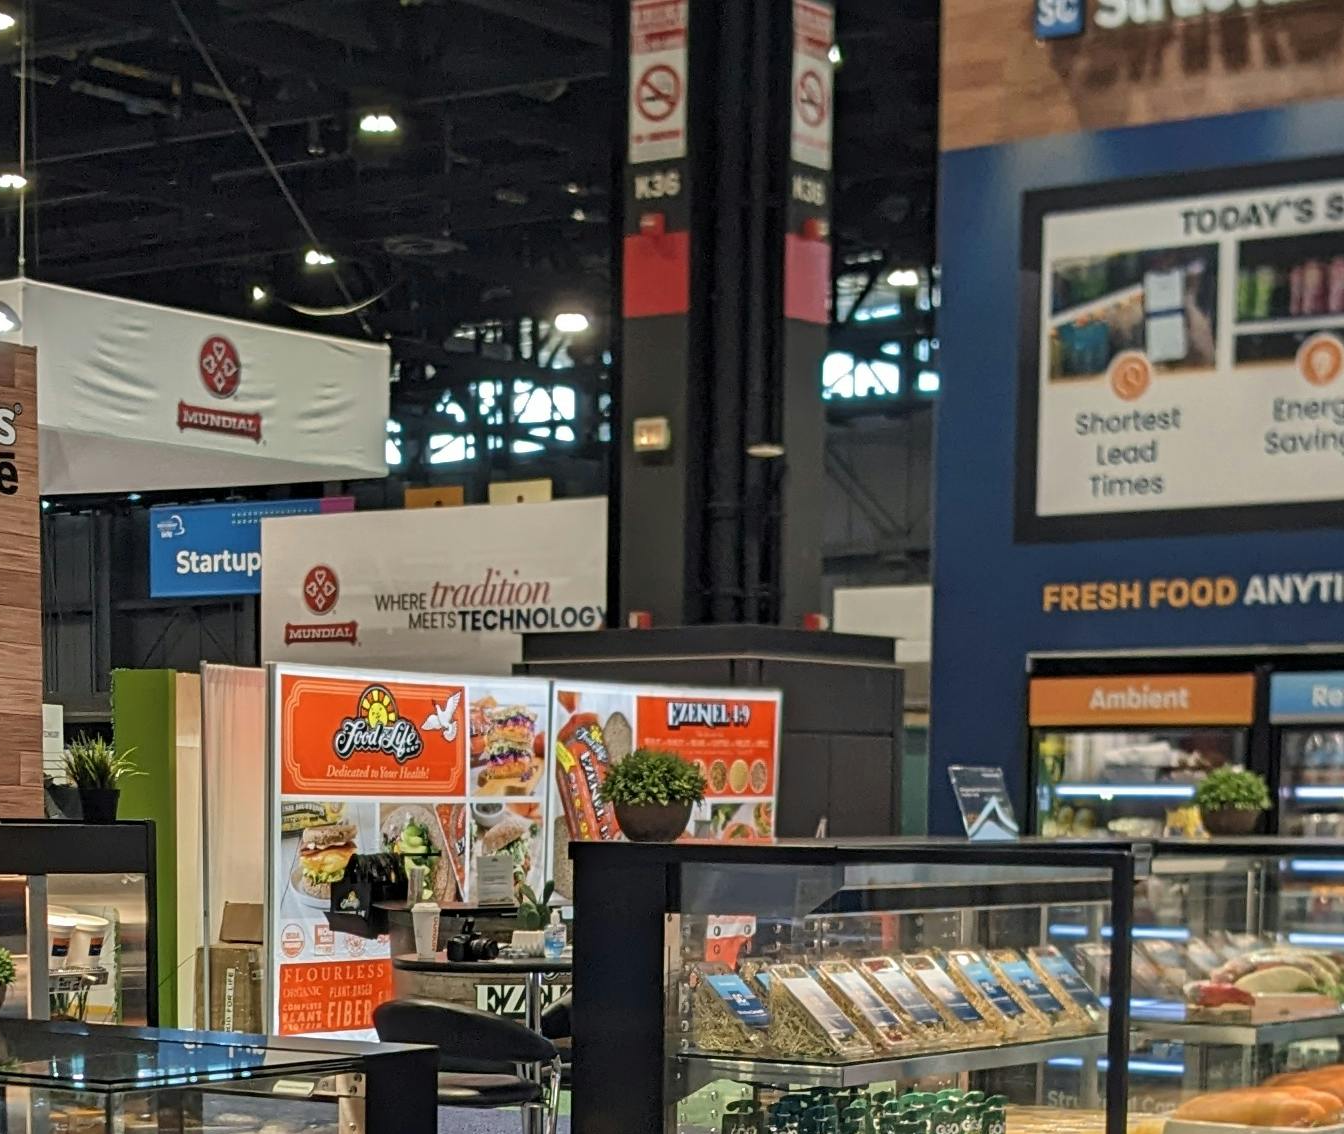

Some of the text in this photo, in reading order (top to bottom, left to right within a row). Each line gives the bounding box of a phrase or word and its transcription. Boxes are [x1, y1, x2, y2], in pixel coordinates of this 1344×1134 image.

[1181, 198, 1314, 235] TODAY'S
[182, 409, 257, 432] MUNDIAL
[1074, 406, 1183, 436] Shortest
[1095, 441, 1159, 467] Lead
[1088, 473, 1165, 499] Times
[375, 568, 551, 612] WHERE tradition
[1042, 583, 1142, 612] FRESH
[1148, 577, 1239, 609] FOOD
[288, 625, 354, 641] MUNDIAL
[408, 611, 456, 630] MEETS
[1088, 685, 1191, 711] Ambient
[327, 764, 370, 778] Dedicated
[380, 766, 399, 779] Your
[283, 964, 384, 983] FLOURLESS
[282, 1011, 323, 1023] PLANT
[327, 999, 373, 1028] FIBER
